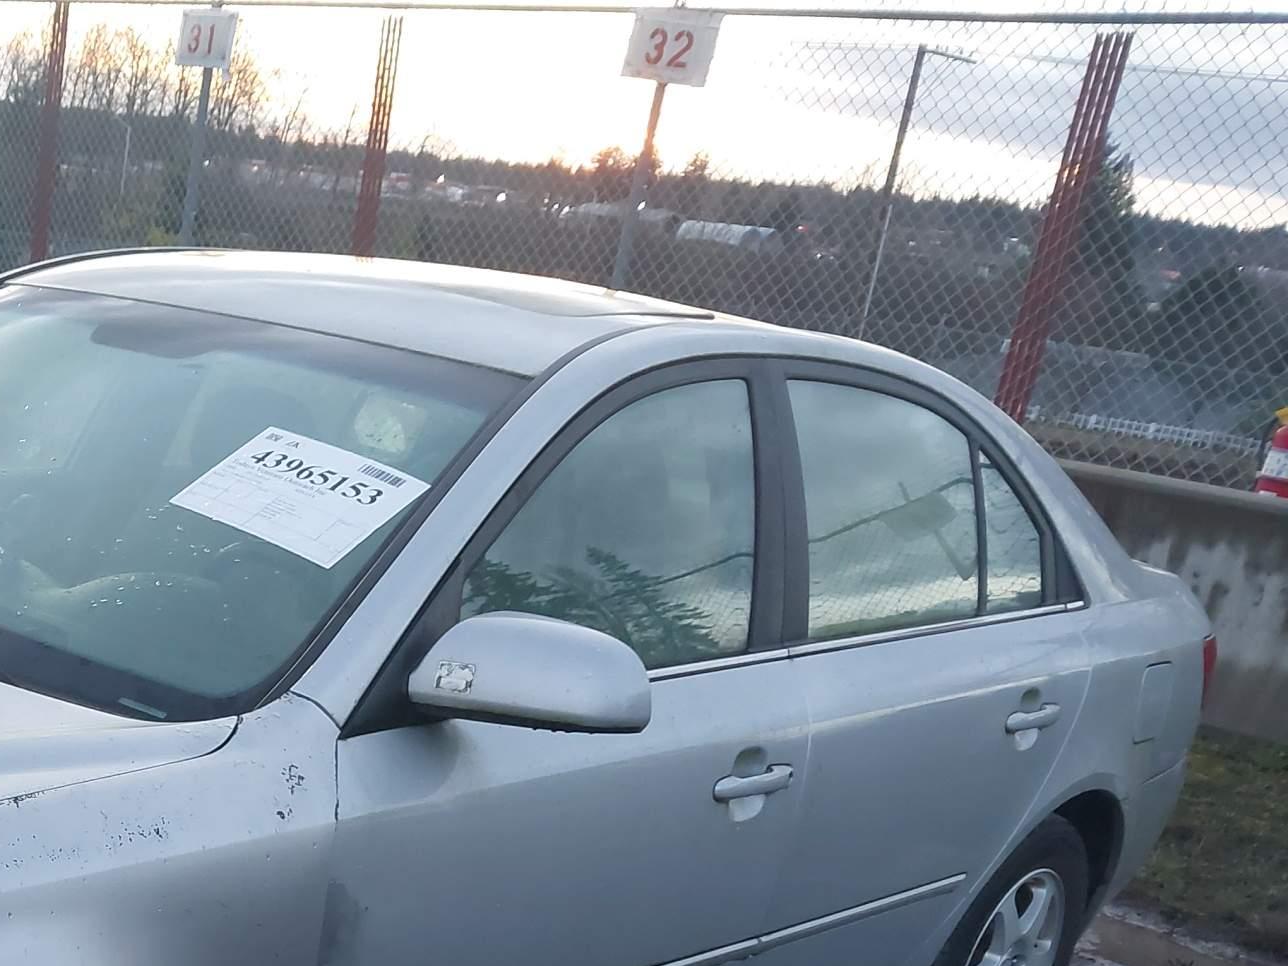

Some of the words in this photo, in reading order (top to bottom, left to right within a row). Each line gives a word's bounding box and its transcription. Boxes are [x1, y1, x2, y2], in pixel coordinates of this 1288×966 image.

[187, 23, 216, 55] 31
[644, 26, 695, 68] 32
[250, 450, 384, 506] 43965153
